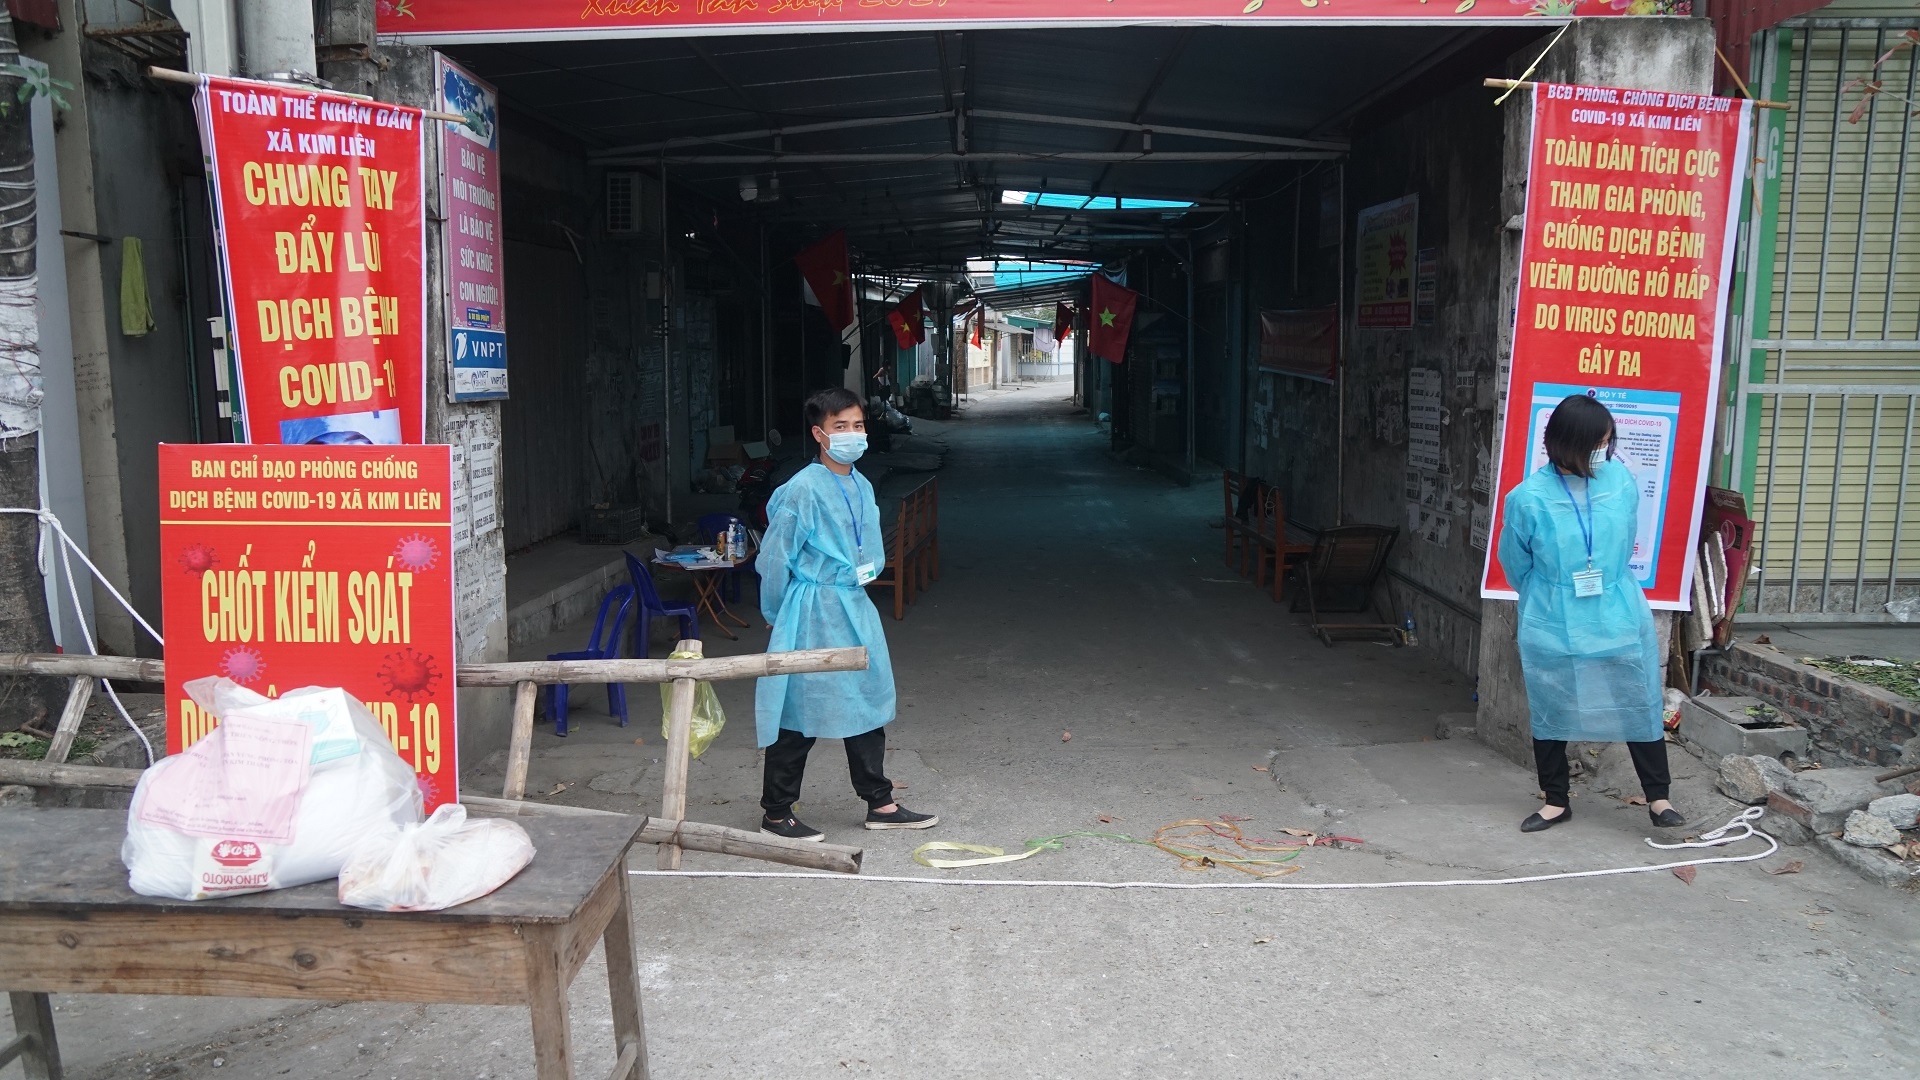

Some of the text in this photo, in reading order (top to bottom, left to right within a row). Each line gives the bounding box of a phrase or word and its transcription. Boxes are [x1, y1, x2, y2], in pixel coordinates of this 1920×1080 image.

[220, 90, 414, 130] TOÀN THỂ NHÂN DÂN
[1547, 84, 1571, 100] BCĐ
[1575, 86, 1620, 104] PHÒNG,
[1667, 95, 1696, 111] DỊCH
[1697, 94, 1731, 112] BỆNH
[1571, 108, 1702, 132] COVID-19 XÃ KIM LIÊN
[267, 128, 376, 159] XÃ KIM LIÊN
[1545, 135, 1591, 169] TOÀN
[1597, 138, 1634, 171] DÂN
[1640, 141, 1678, 175] TÍCH
[1684, 146, 1720, 183] CỰC
[461, 144, 486, 180] BẢO VỆ
[243, 161, 398, 211] CHUNG TAY
[453, 177, 496, 212] MÔI TRƯỜNG
[1550, 180, 1707, 222] THAM GIA PHÒNG,
[276, 213, 382, 274] ĐẨY LÙI
[460, 211, 494, 246] LÀ BẢO VỆ
[1543, 214, 1605, 252] CHỐNG
[1609, 226, 1652, 259] DỊCH
[1656, 226, 1705, 263] BỆNH
[460, 245, 475, 269] SỨC
[460, 281, 475, 303] CON
[1530, 257, 1711, 300] VIÊM ĐƯỜNG HÔ HẤP
[257, 288, 399, 351] DỊCH BỆNH
[1534, 303, 1560, 330] DO
[1565, 305, 1616, 335] VIRUS
[1621, 309, 1696, 341] CORONA
[471, 340, 503, 359] VNPT
[1578, 343, 1641, 377] GÂY RA
[279, 359, 396, 409] COVID-1
[1638, 419, 1662, 427] COVID-19
[191, 453, 418, 482] BAN CHỈ ĐẠO PHÒNG CHỐNG
[170, 489, 209, 513] DỊCH
[213, 487, 257, 513] BỆNH
[262, 490, 334, 511] COVID-19
[340, 486, 363, 511] XÃ
[367, 490, 399, 511] KIM
[404, 486, 441, 511] LIÊN
[202, 539, 413, 644] CHỐT KIỂM SOÁT
